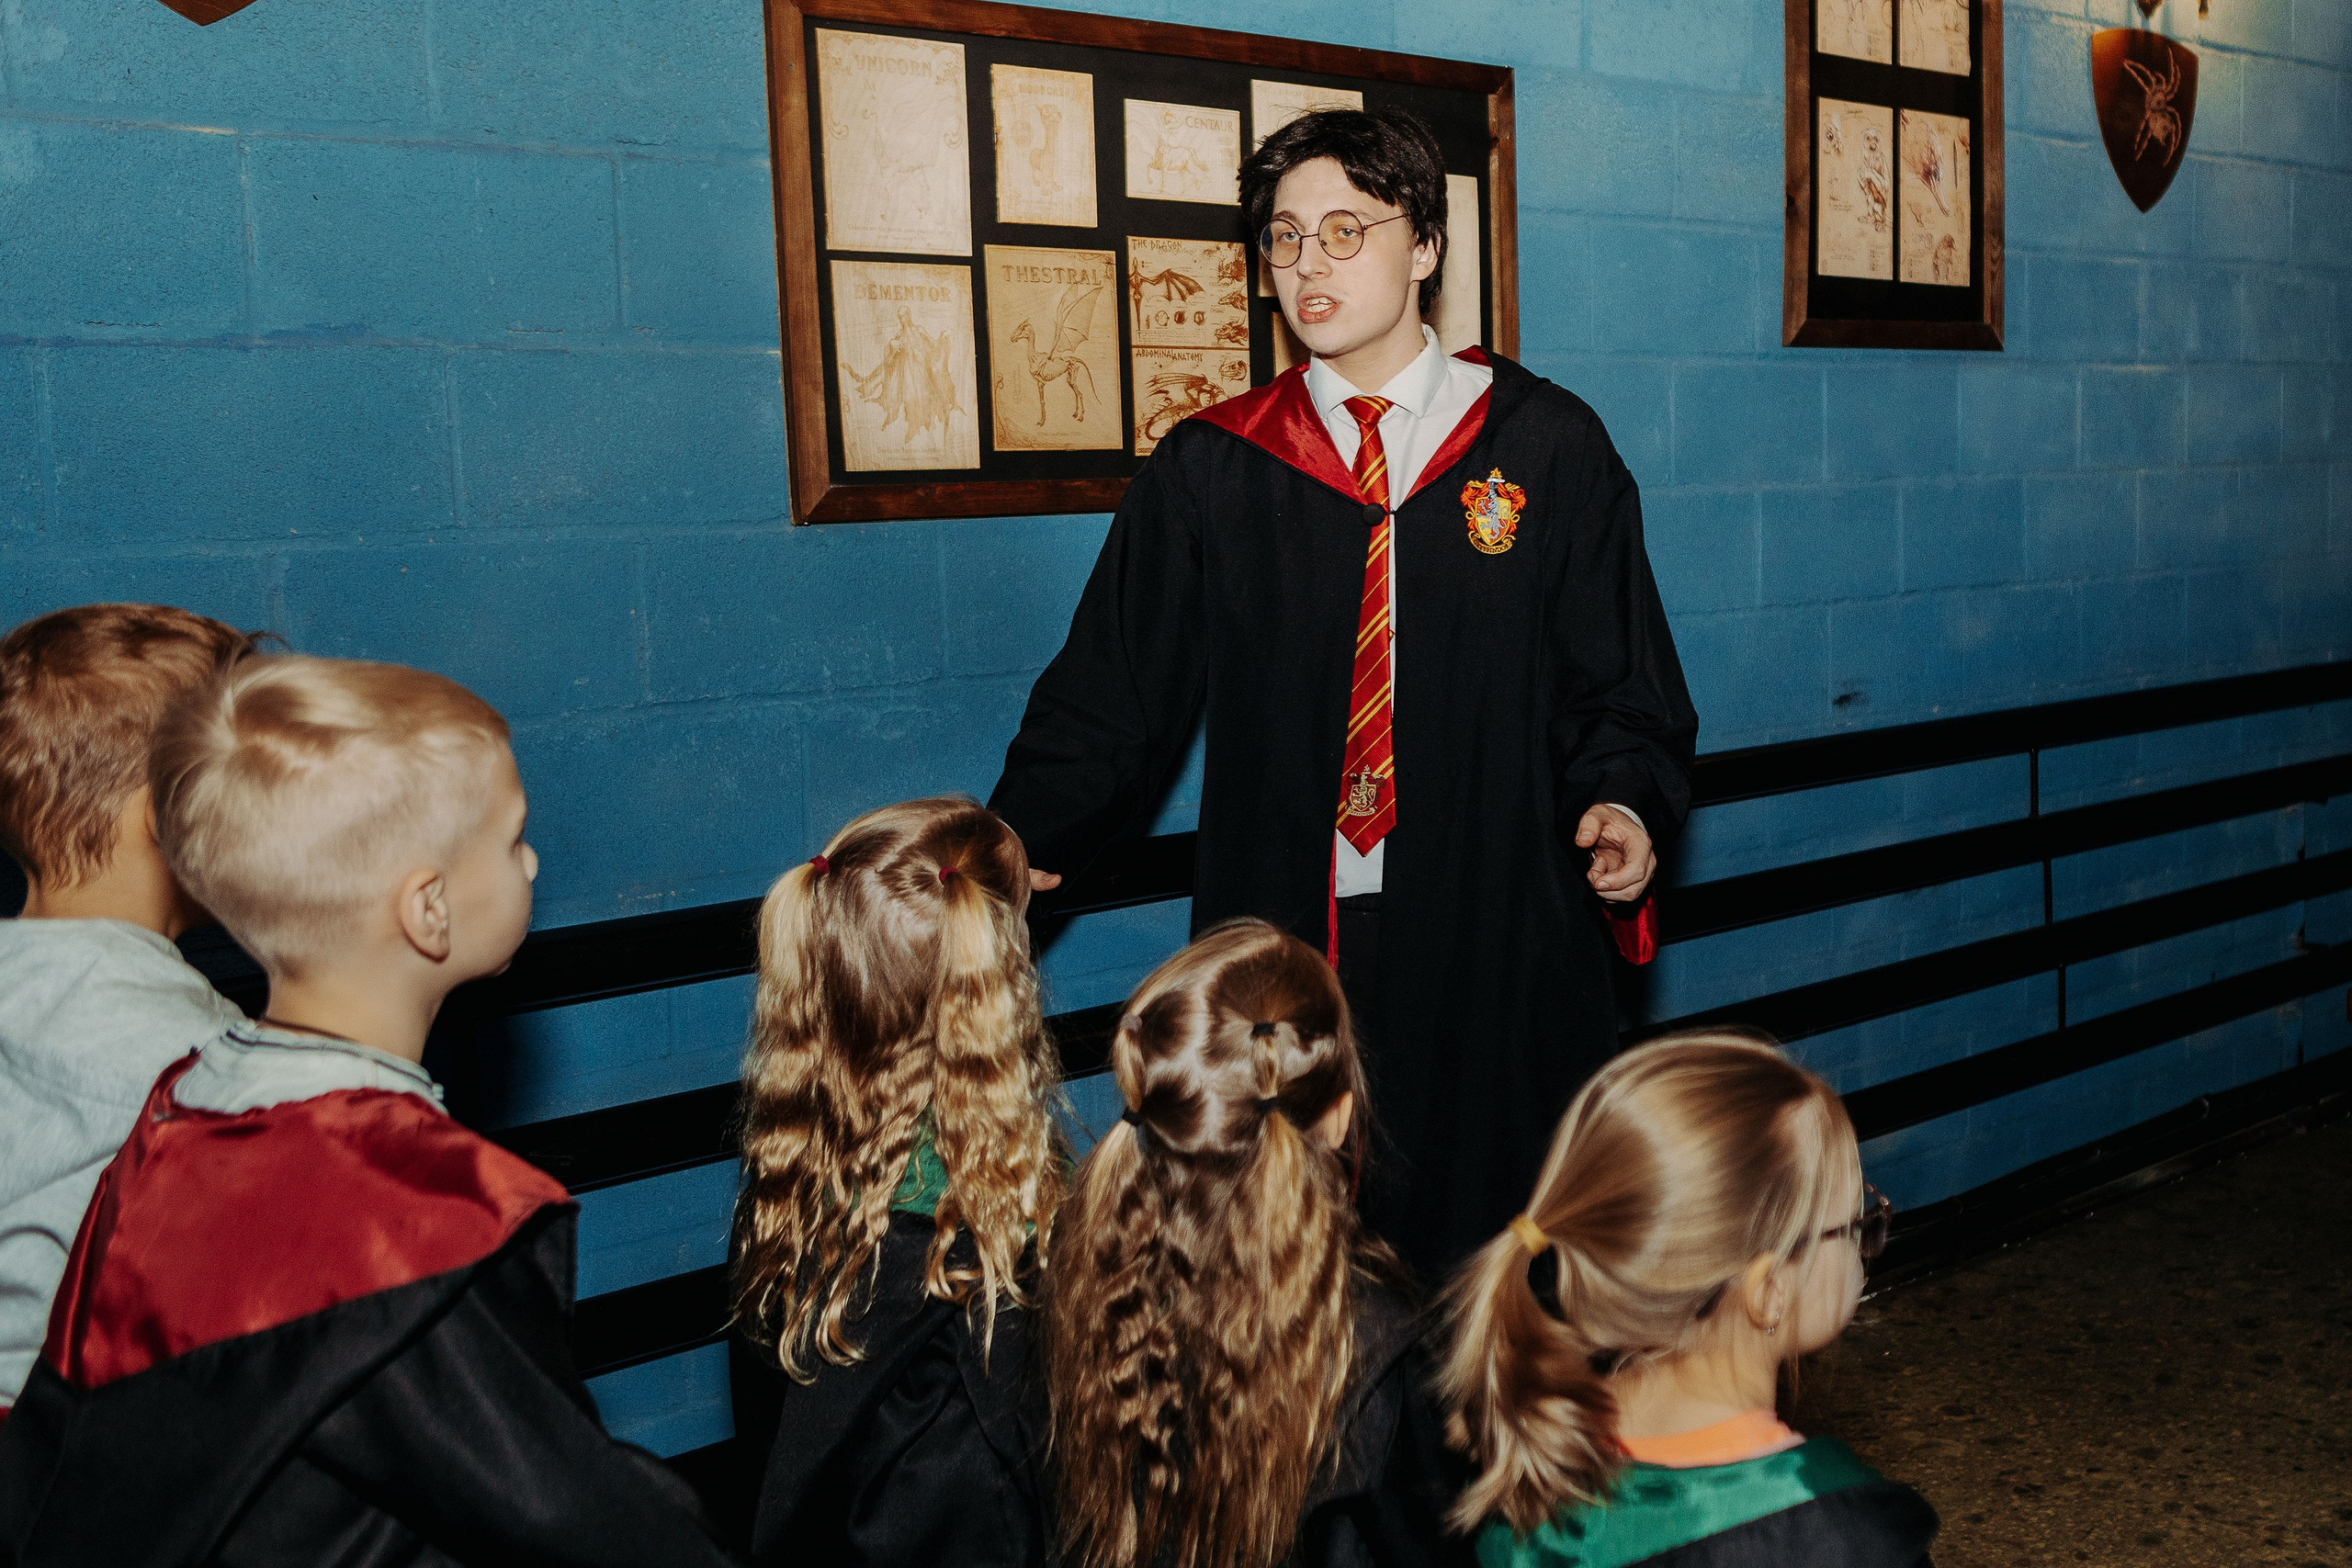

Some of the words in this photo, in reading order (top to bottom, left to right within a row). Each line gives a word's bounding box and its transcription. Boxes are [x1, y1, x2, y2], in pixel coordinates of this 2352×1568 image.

[854, 55, 933, 77] UNICORN
[1185, 116, 1235, 132] CENTAUR
[1131, 239, 1148, 251] THE
[1150, 240, 1182, 251] DRAGON
[1001, 265, 1102, 286] THESTRAL
[854, 283, 952, 302] DEMENTOR
[1136, 349, 1173, 358] ABDOMINAL
[1171, 352, 1204, 362] ANATOMY
